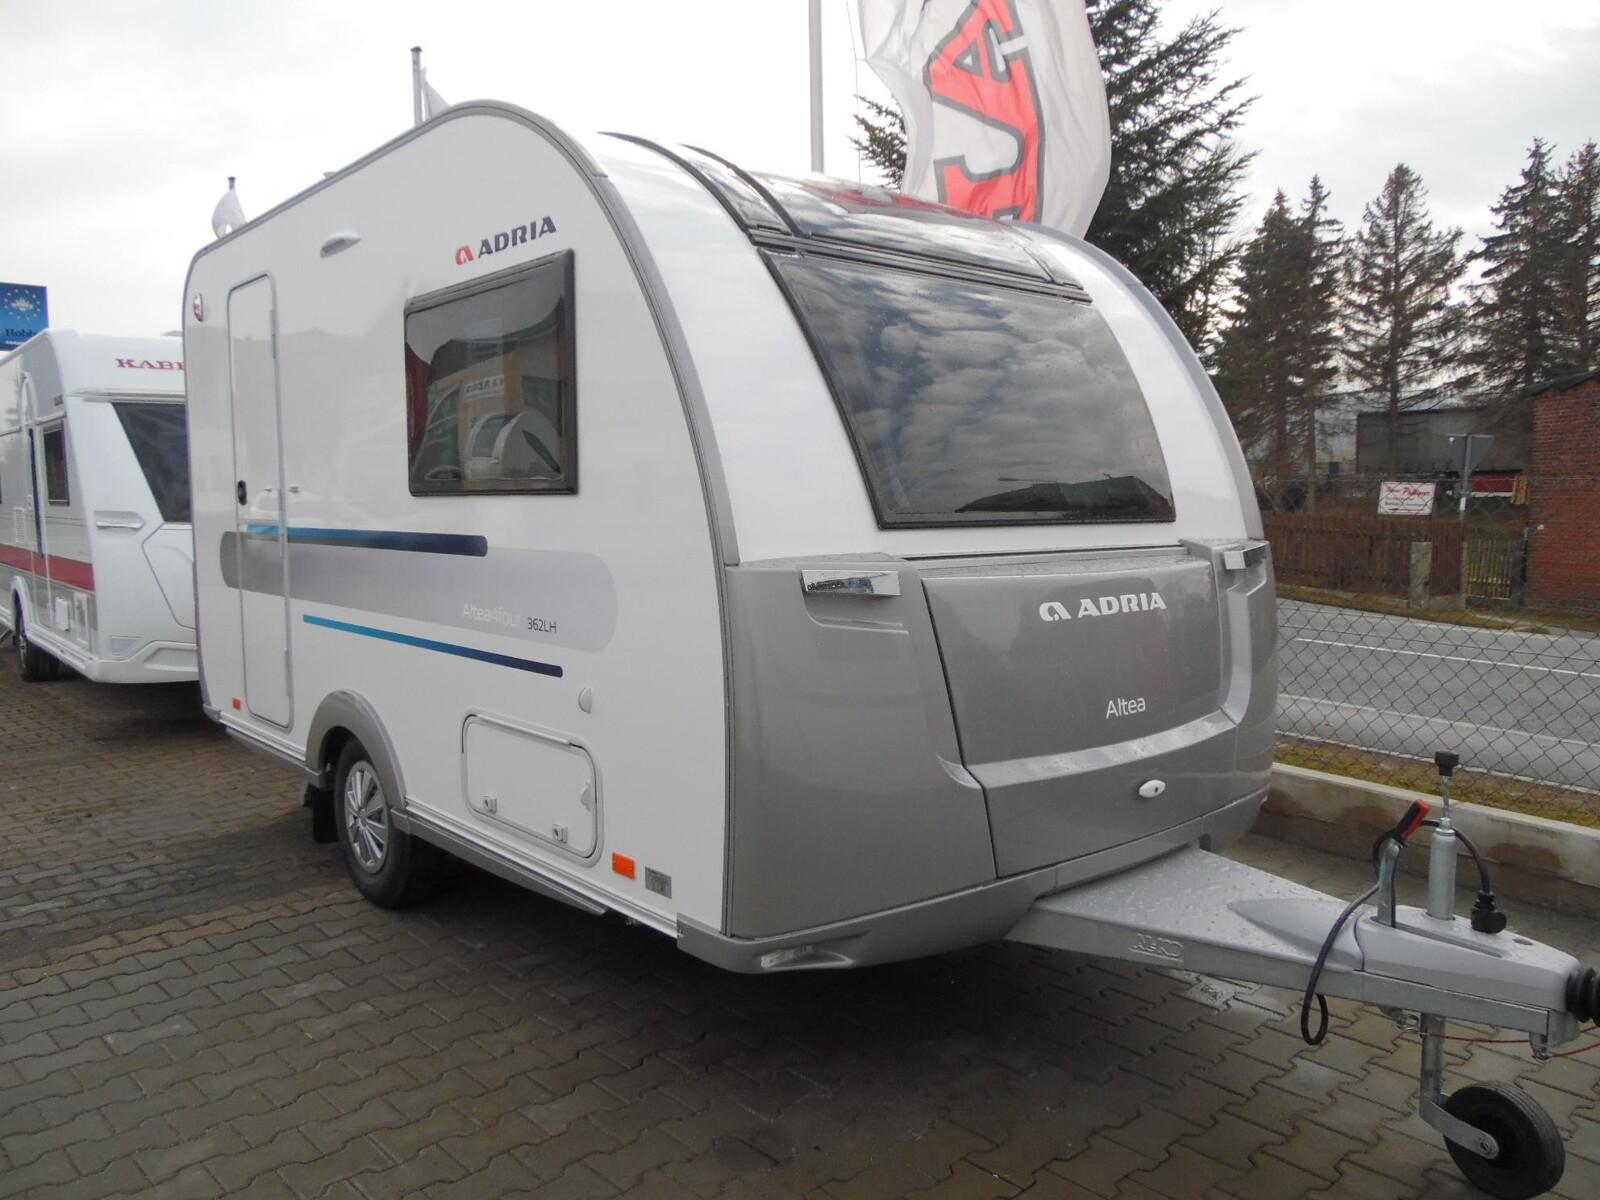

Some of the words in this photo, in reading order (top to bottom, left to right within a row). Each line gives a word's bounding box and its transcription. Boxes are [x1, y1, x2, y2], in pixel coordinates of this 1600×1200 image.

[477, 215, 557, 259] ADRIA
[1077, 592, 1167, 618] ADRIA
[527, 617, 557, 633] 362LH
[1105, 697, 1146, 719] Altea
